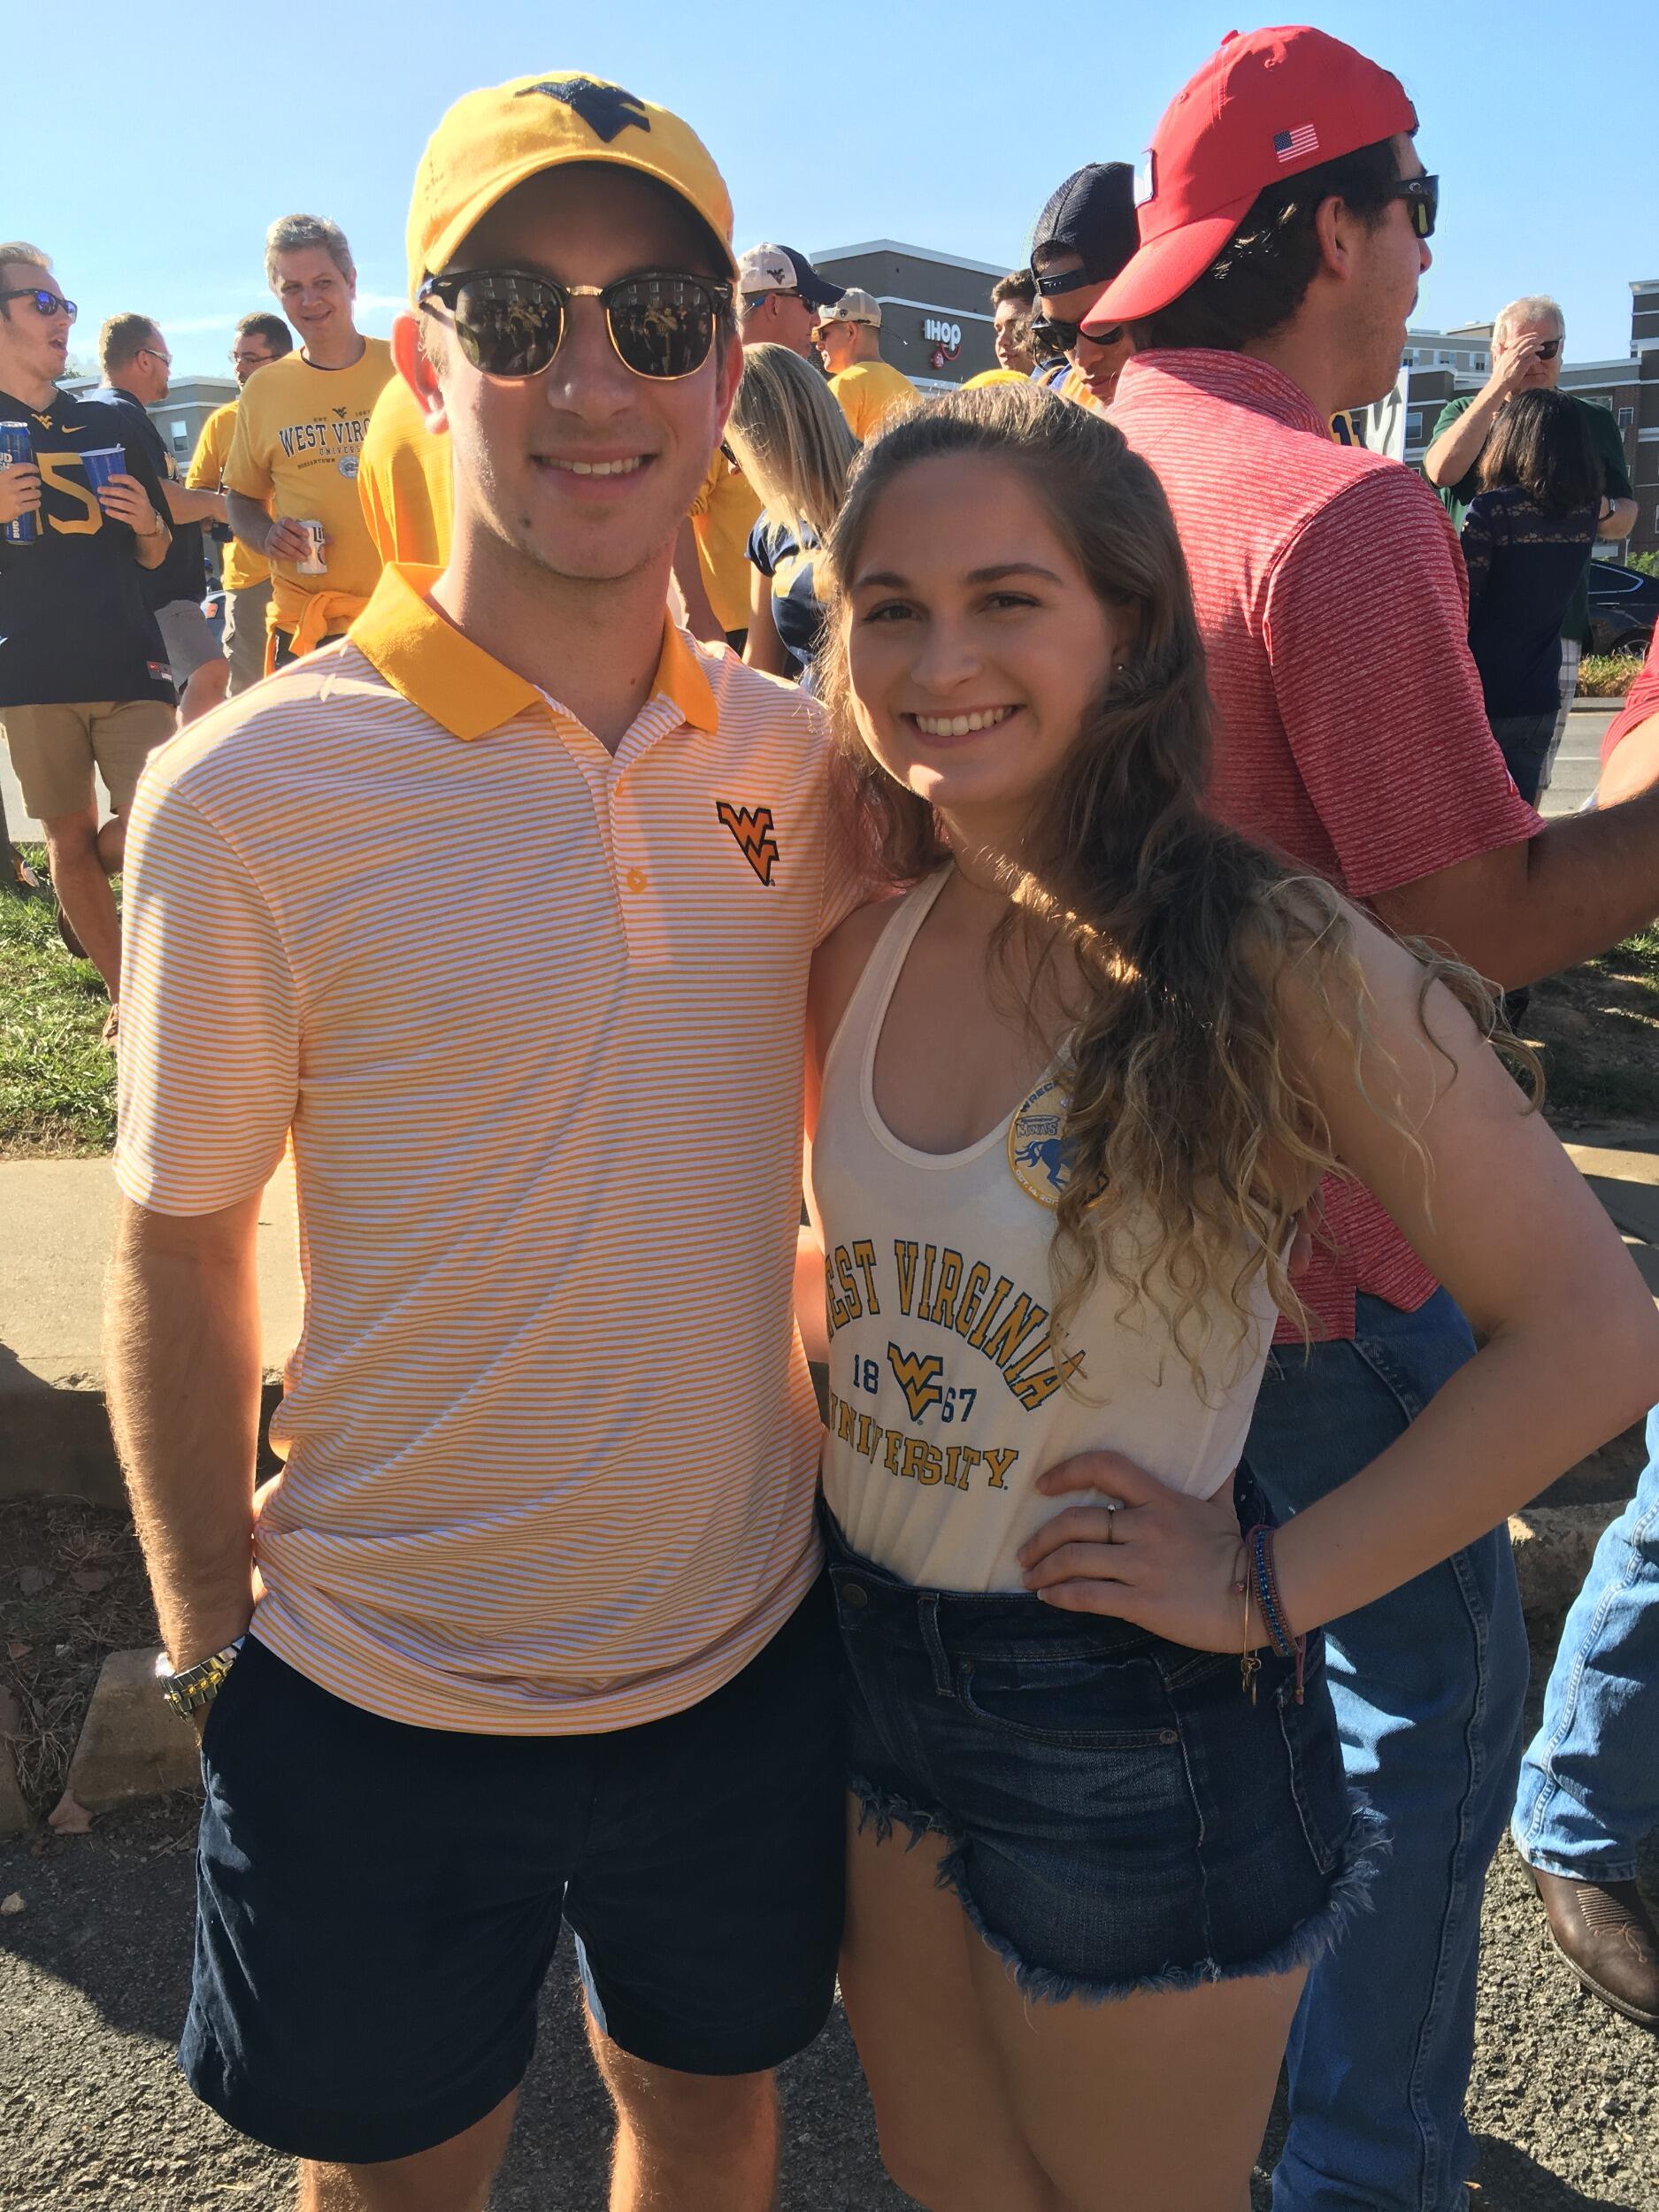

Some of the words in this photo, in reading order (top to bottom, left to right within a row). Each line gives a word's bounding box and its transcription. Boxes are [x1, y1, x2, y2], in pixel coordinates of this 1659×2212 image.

[279, 424, 326, 458] WEST
[1020, 1081, 1056, 1112] WREC
[826, 1239, 880, 1343] EST
[894, 1239, 1087, 1411] VIRGINIA
[852, 1354, 879, 1394] 18
[941, 1386, 978, 1423] 67
